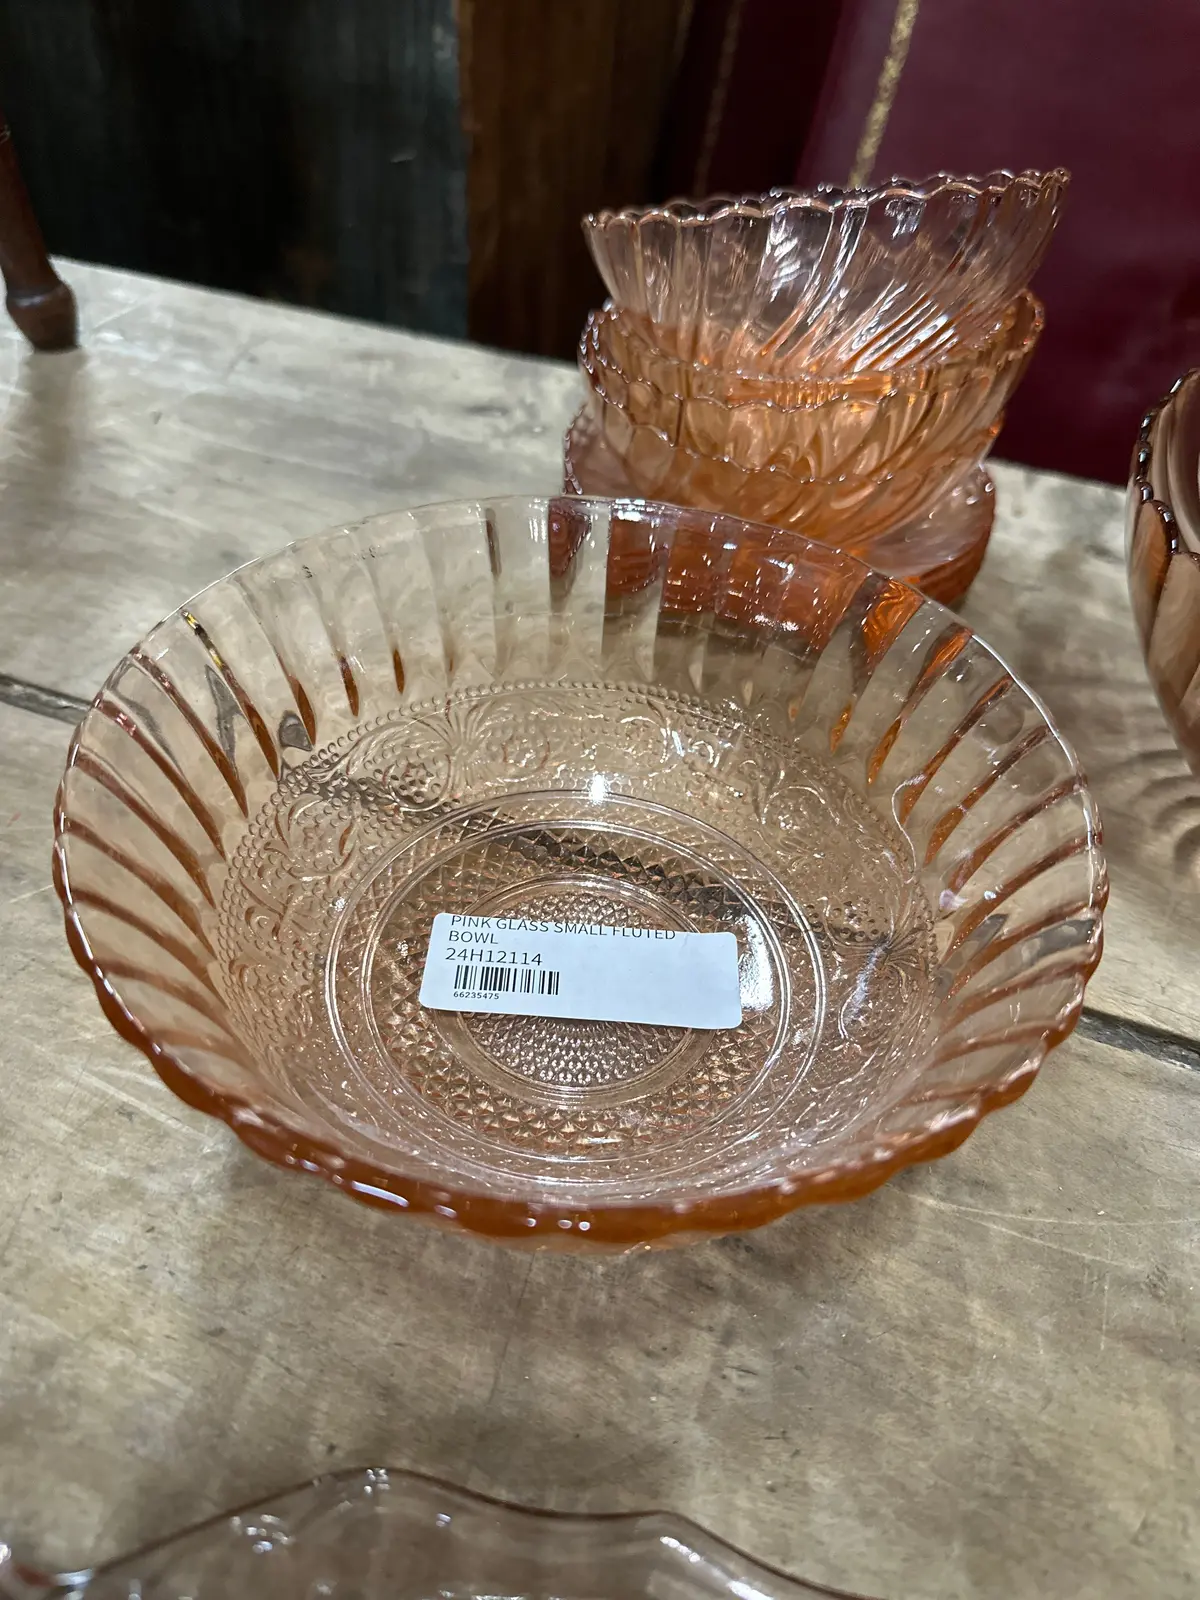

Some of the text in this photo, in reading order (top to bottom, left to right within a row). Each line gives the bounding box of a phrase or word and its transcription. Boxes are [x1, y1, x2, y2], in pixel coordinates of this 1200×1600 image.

[451, 915, 491, 928] PINK
[497, 918, 549, 932] GLASS
[554, 921, 607, 936] SMALL
[449, 930, 499, 945] BOWL
[445, 947, 543, 966] 24H12114
[453, 991, 500, 1000] 66235475
